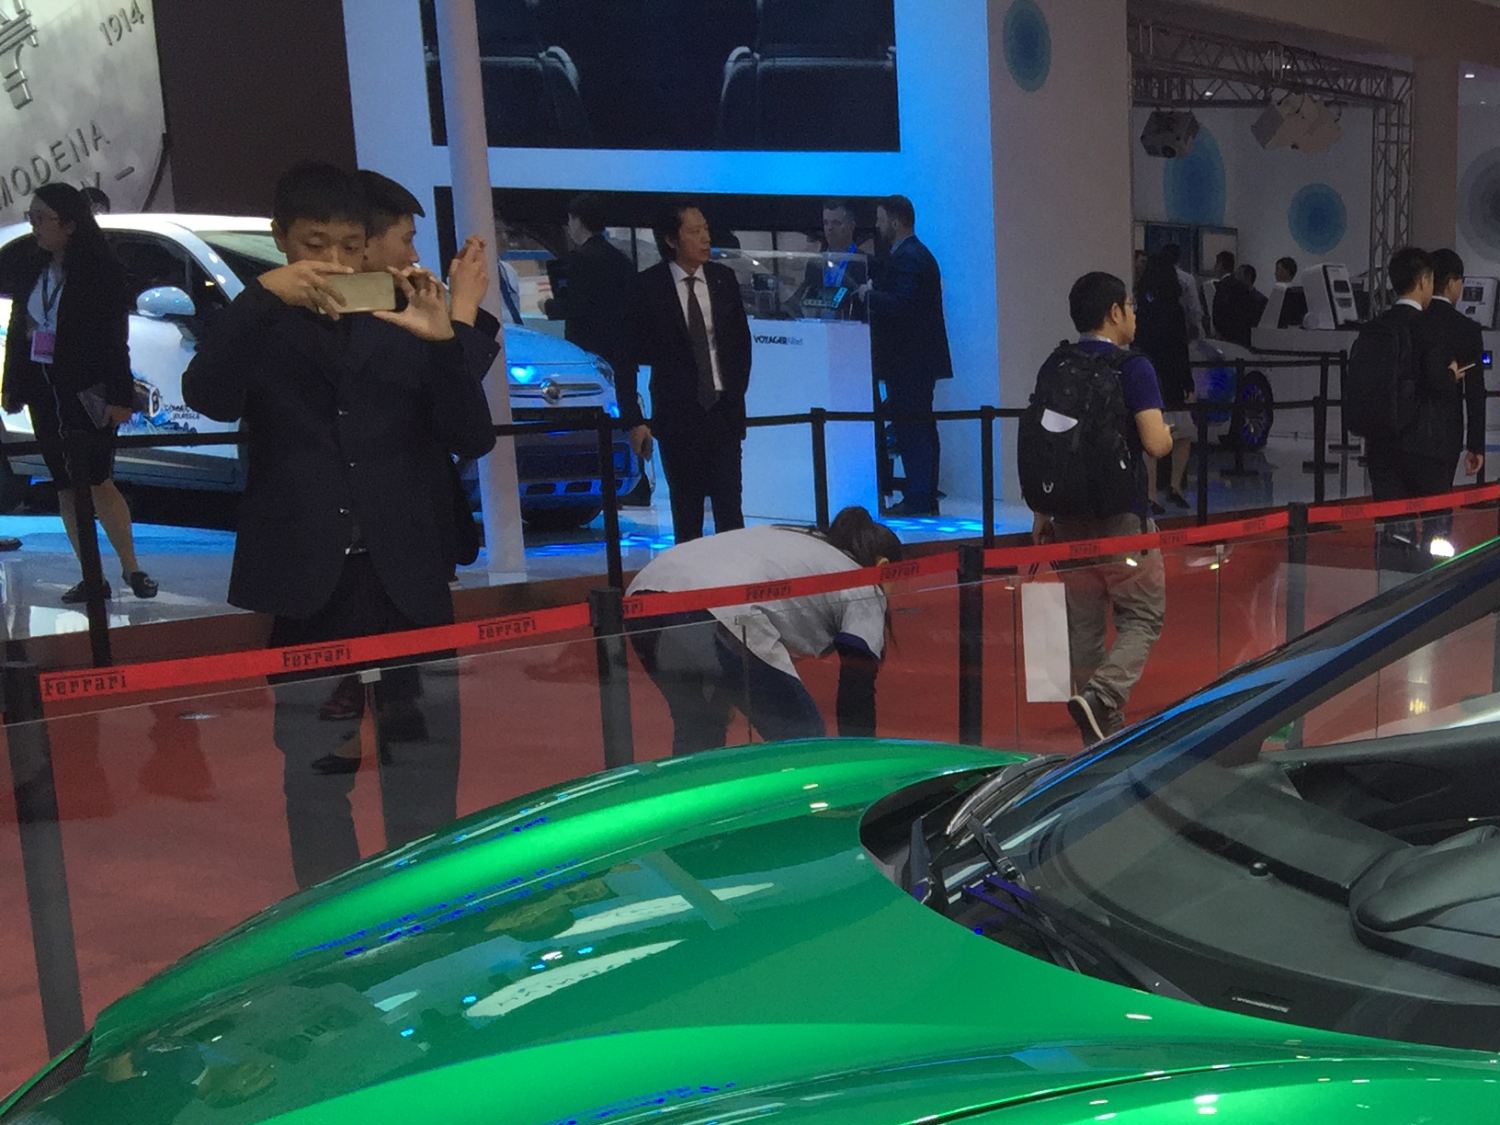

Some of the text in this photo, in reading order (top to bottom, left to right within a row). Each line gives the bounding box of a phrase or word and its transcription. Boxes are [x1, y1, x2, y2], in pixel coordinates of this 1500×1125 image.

[99, 0, 145, 46] 1914
[478, 616, 537, 640] Ferrari
[283, 644, 351, 668] Ferrari
[44, 671, 128, 697] Ferrari
